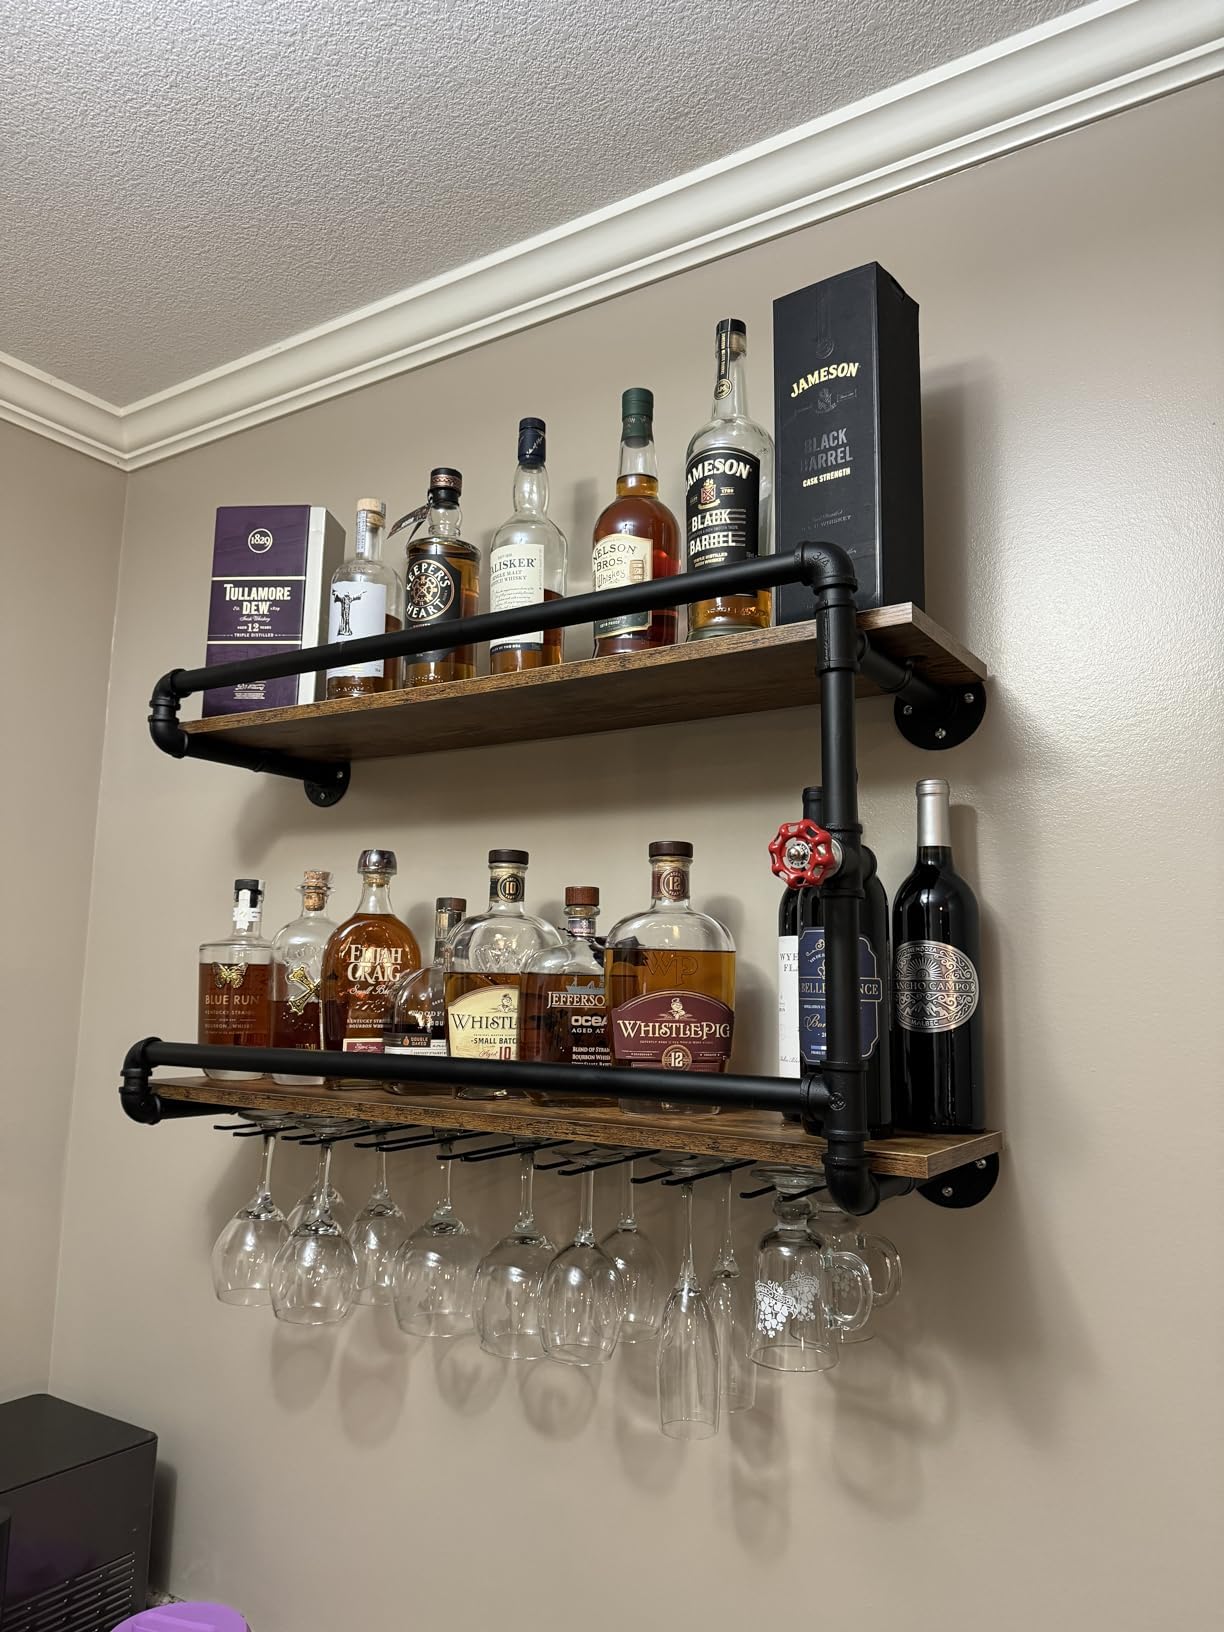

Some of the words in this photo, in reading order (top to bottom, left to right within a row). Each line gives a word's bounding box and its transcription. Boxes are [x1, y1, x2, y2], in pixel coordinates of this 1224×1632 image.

[790, 362, 860, 398] JAMESON
[686, 458, 751, 492] AMESON
[802, 476, 819, 487] CASK
[819, 466, 851, 483] STRENGTH
[691, 508, 731, 533] BLACK
[251, 533, 271, 548] 1829
[689, 531, 737, 556] BARREL
[596, 556, 627, 572] BROS.
[223, 583, 292, 601] TULLAMORE
[406, 597, 445, 618] HEART
[247, 622, 260, 632] 12
[669, 876, 681, 890] 12
[348, 944, 403, 967] ELIJAH
[347, 962, 401, 985] CRAIG
[929, 982, 970, 991] CAMPO
[205, 994, 230, 1005] BLUE
[233, 994, 260, 1005] RUN
[616, 1019, 731, 1041] WHISTLEPIG
[911, 1019, 939, 1027] MALBEC
[499, 1045, 512, 1060] 10
[670, 1052, 684, 1067] 12
